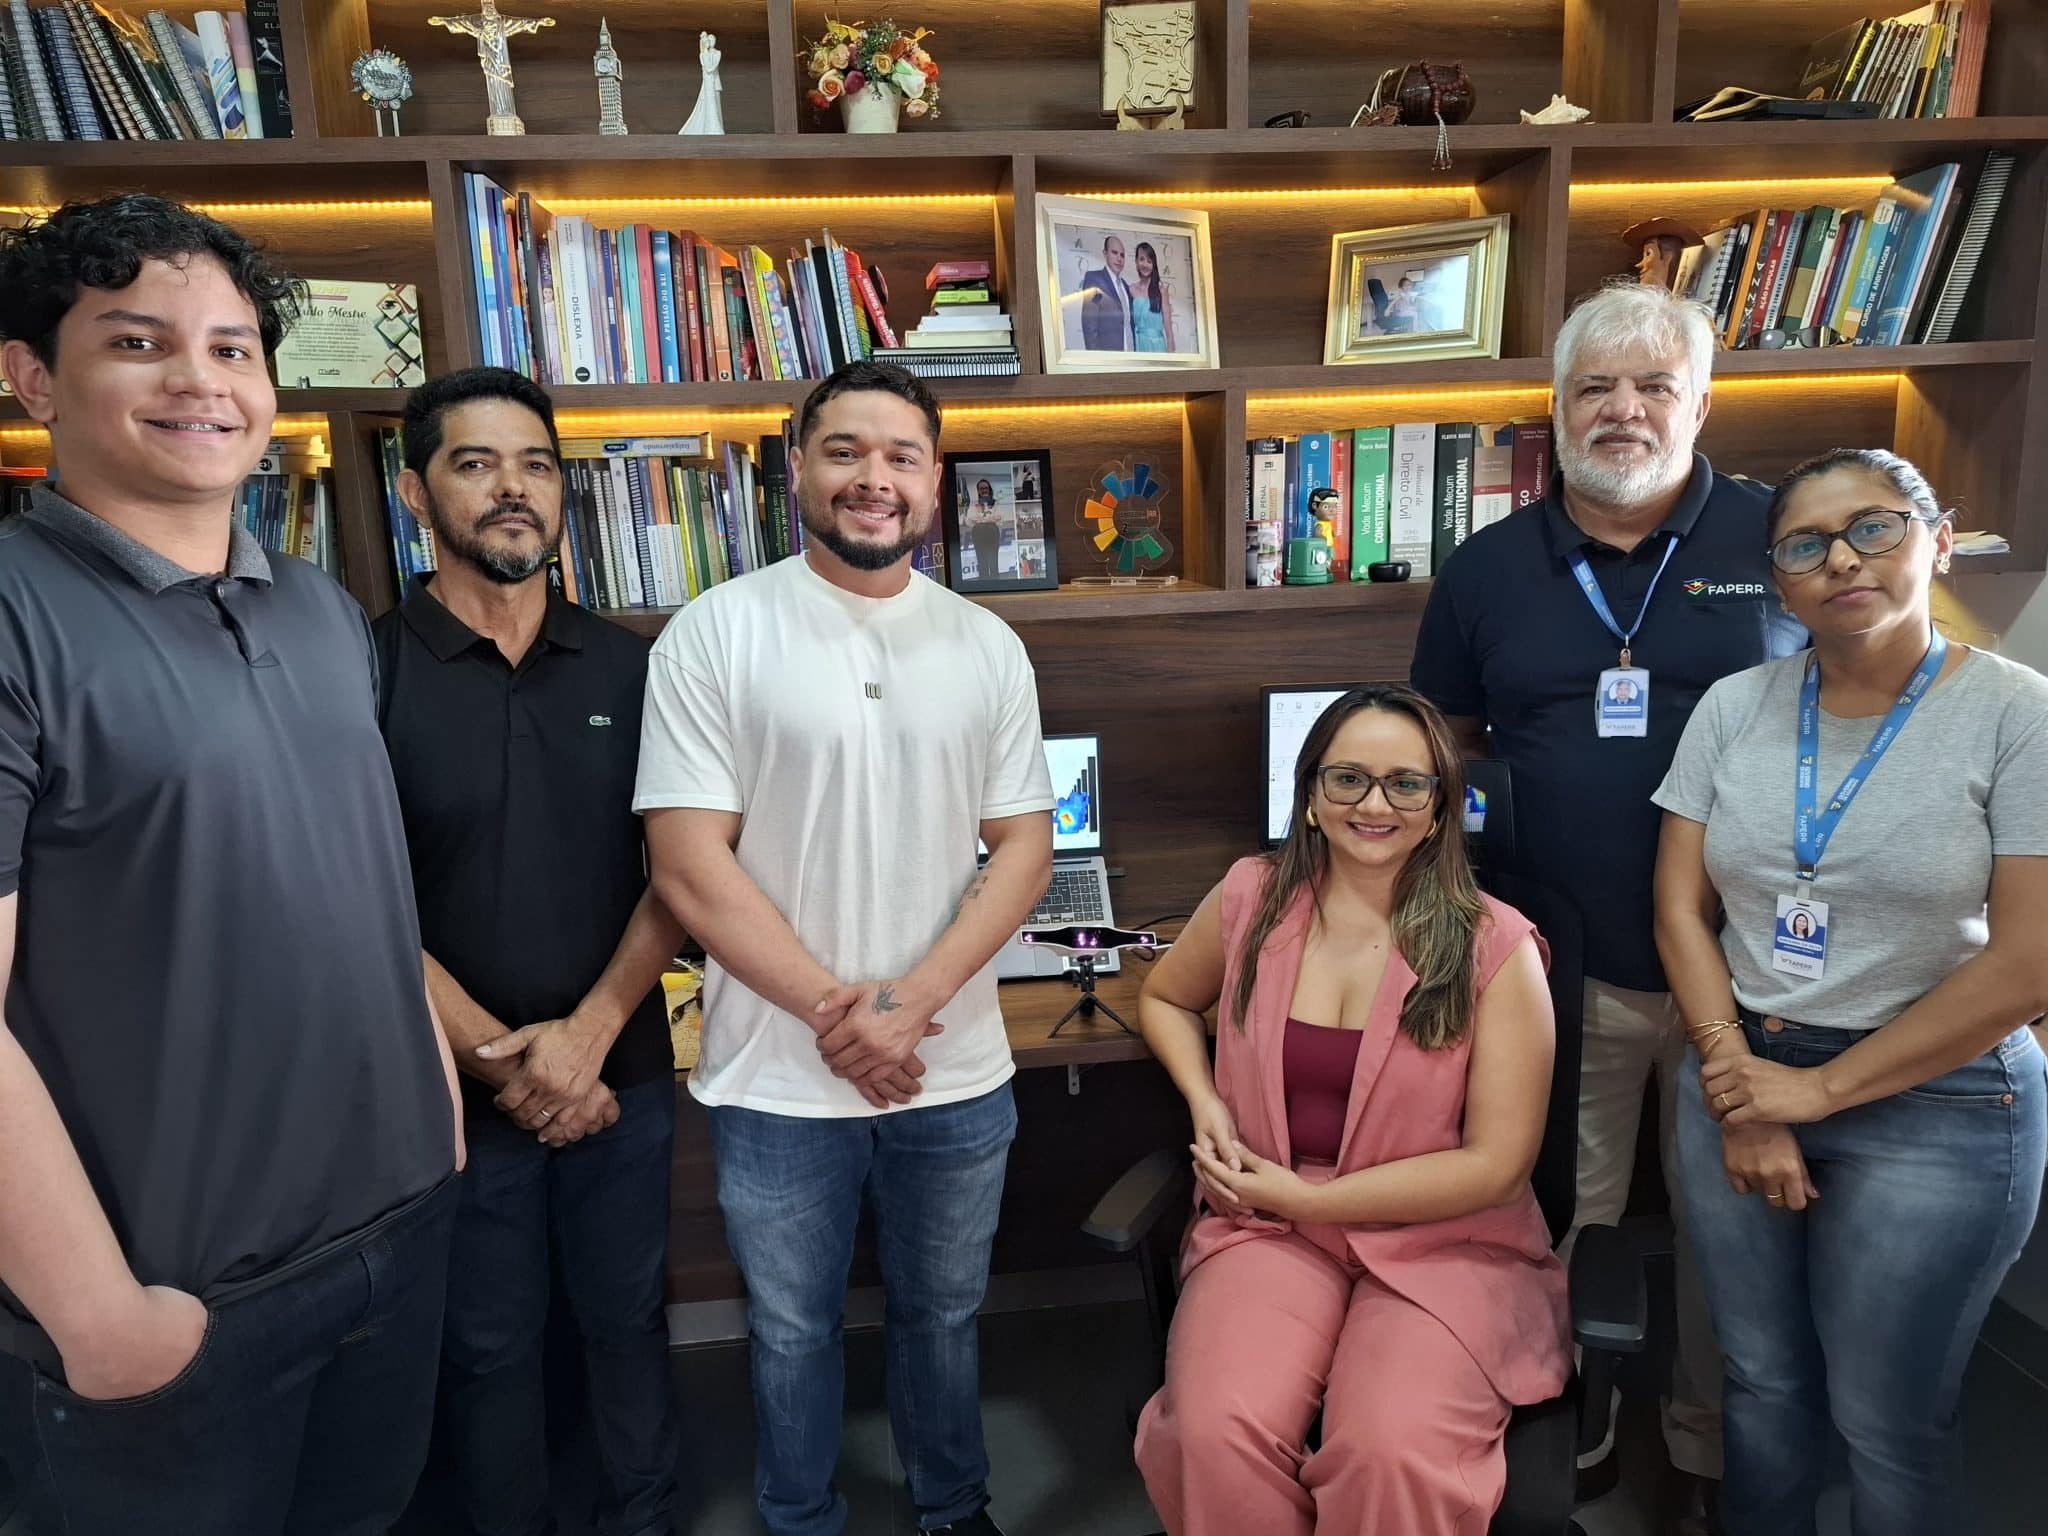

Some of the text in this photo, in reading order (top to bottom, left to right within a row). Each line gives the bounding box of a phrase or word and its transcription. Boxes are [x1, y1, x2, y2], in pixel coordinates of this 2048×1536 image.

[327, 305, 368, 318] Mestre
[571, 296, 582, 340] DISLEXIA
[1400, 452, 1414, 520] Direito Civil
[1443, 475, 1454, 506] Mecum
[1534, 452, 1543, 495] Comentado
[1361, 482, 1372, 513] Mecum
[1374, 473, 1385, 544] CONSTITUCIONAL
[1454, 456, 1468, 546] CONSTITUCIONAL
[1708, 584, 1764, 596] FAPERR
